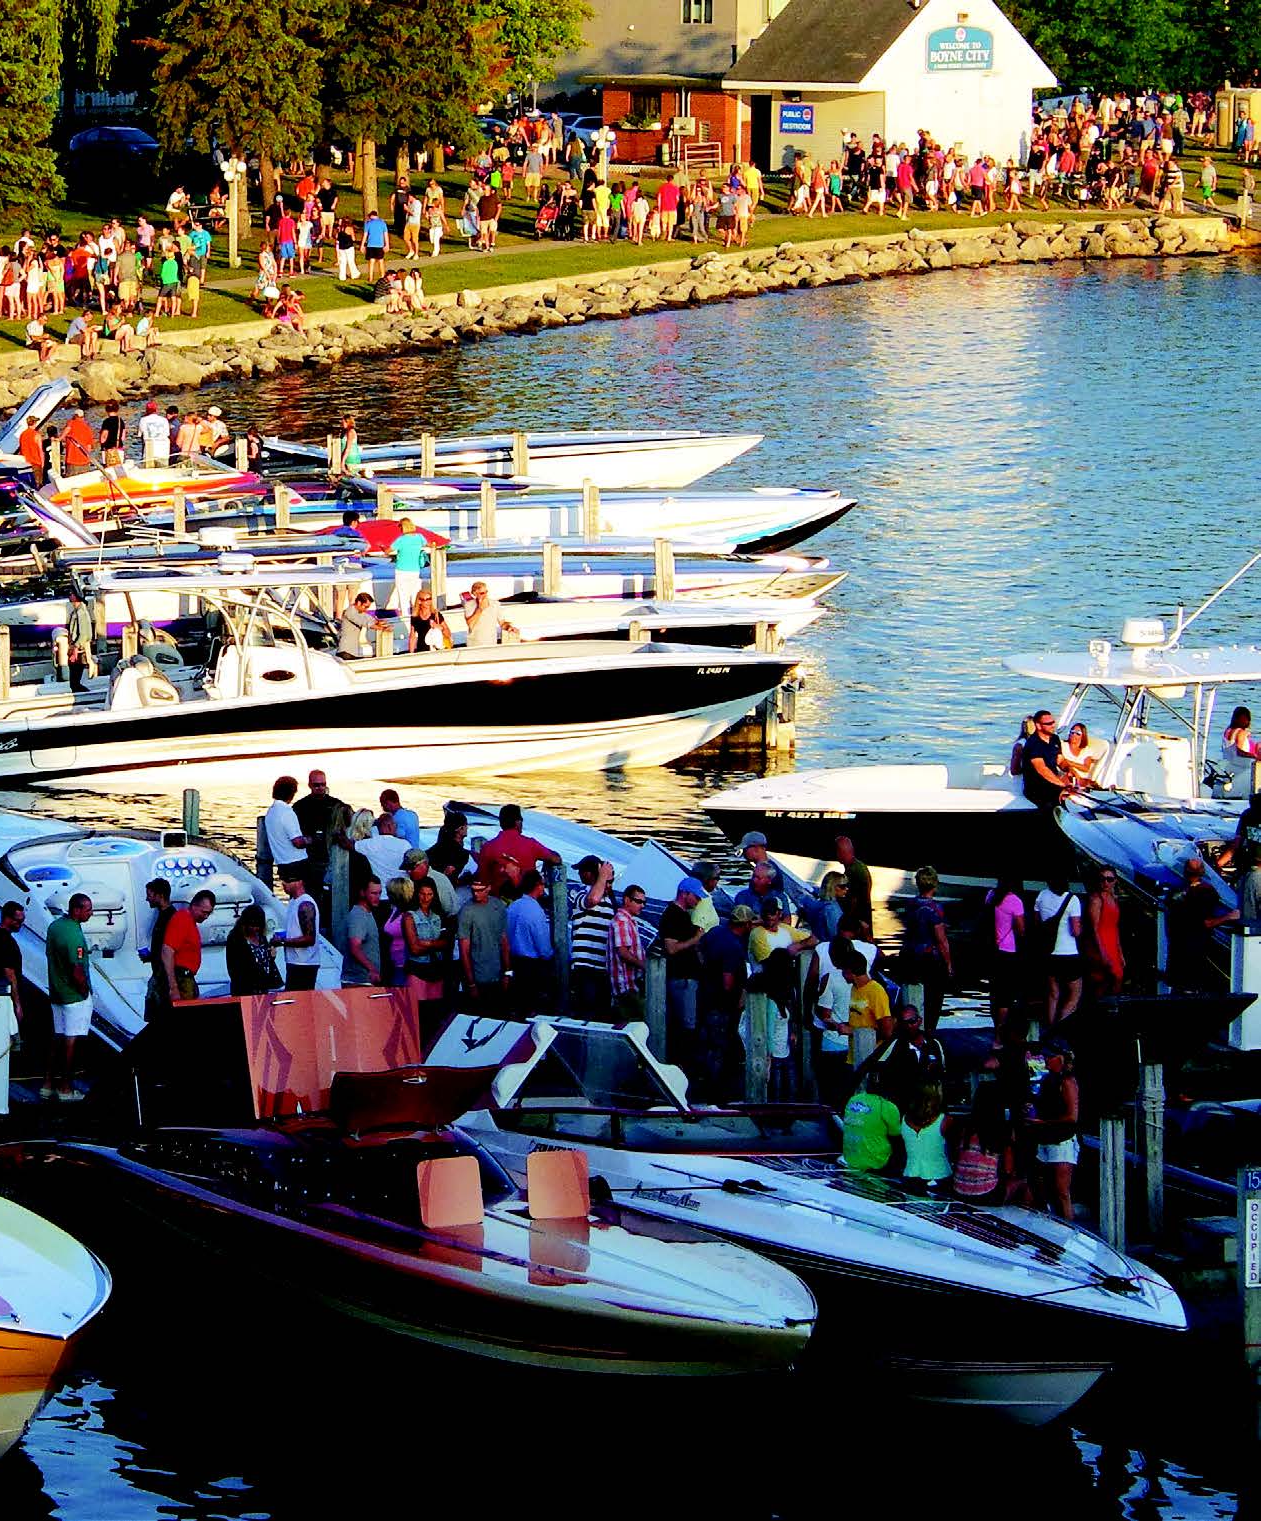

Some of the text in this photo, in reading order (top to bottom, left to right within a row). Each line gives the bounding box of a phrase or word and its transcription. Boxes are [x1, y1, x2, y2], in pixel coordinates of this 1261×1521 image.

[939, 41, 982, 49] WELCOME TO
[930, 50, 990, 62] BOYNE CITY
[782, 110, 802, 118] PUBLIC
[1247, 1171, 1261, 1189] 15
[1250, 1203, 1259, 1281] OCCUPIED
